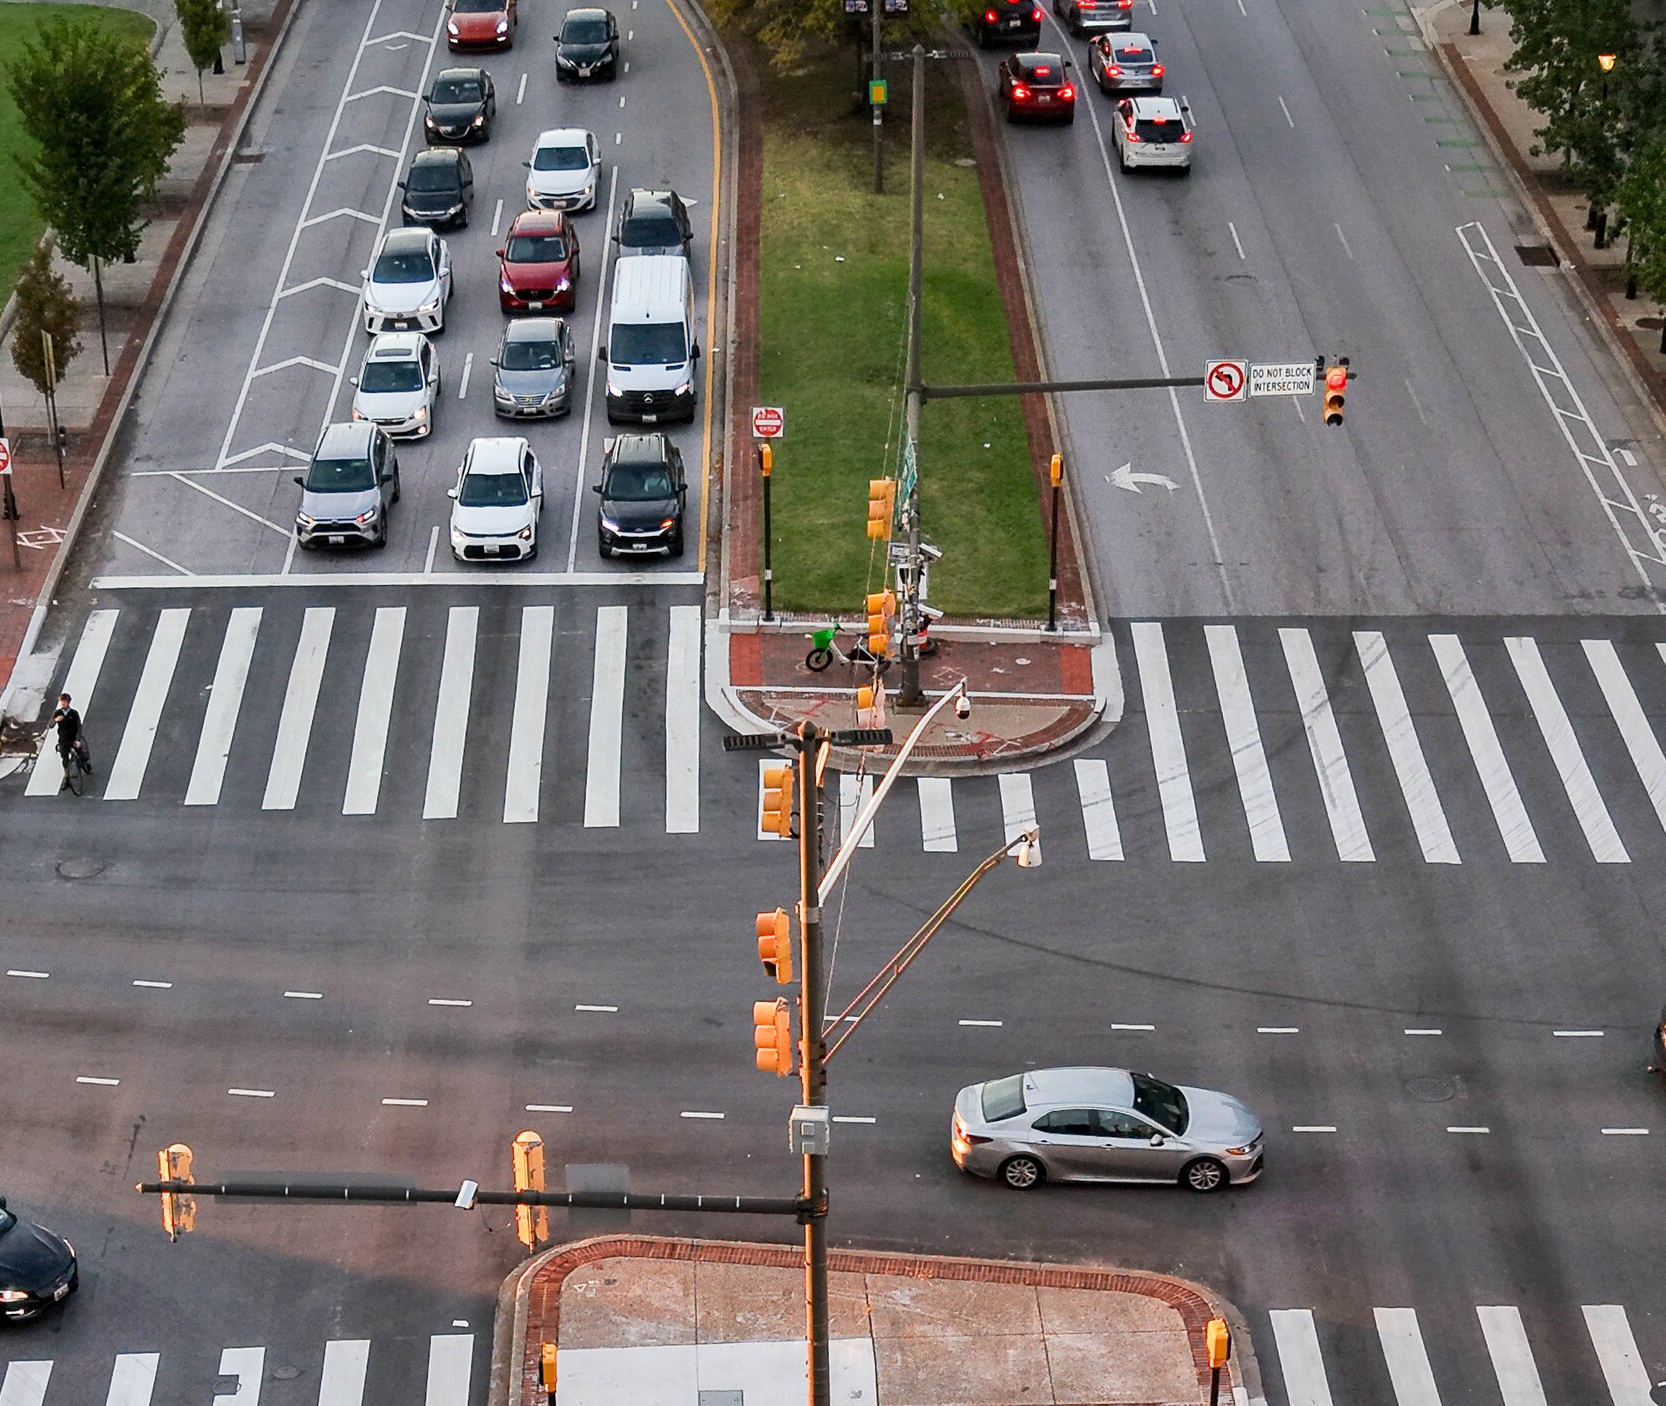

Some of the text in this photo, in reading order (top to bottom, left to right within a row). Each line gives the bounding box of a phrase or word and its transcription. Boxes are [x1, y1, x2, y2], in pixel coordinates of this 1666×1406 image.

[1253, 367, 1312, 379] DO NOT BLOCK
[1254, 381, 1310, 391] INTERSECTION
